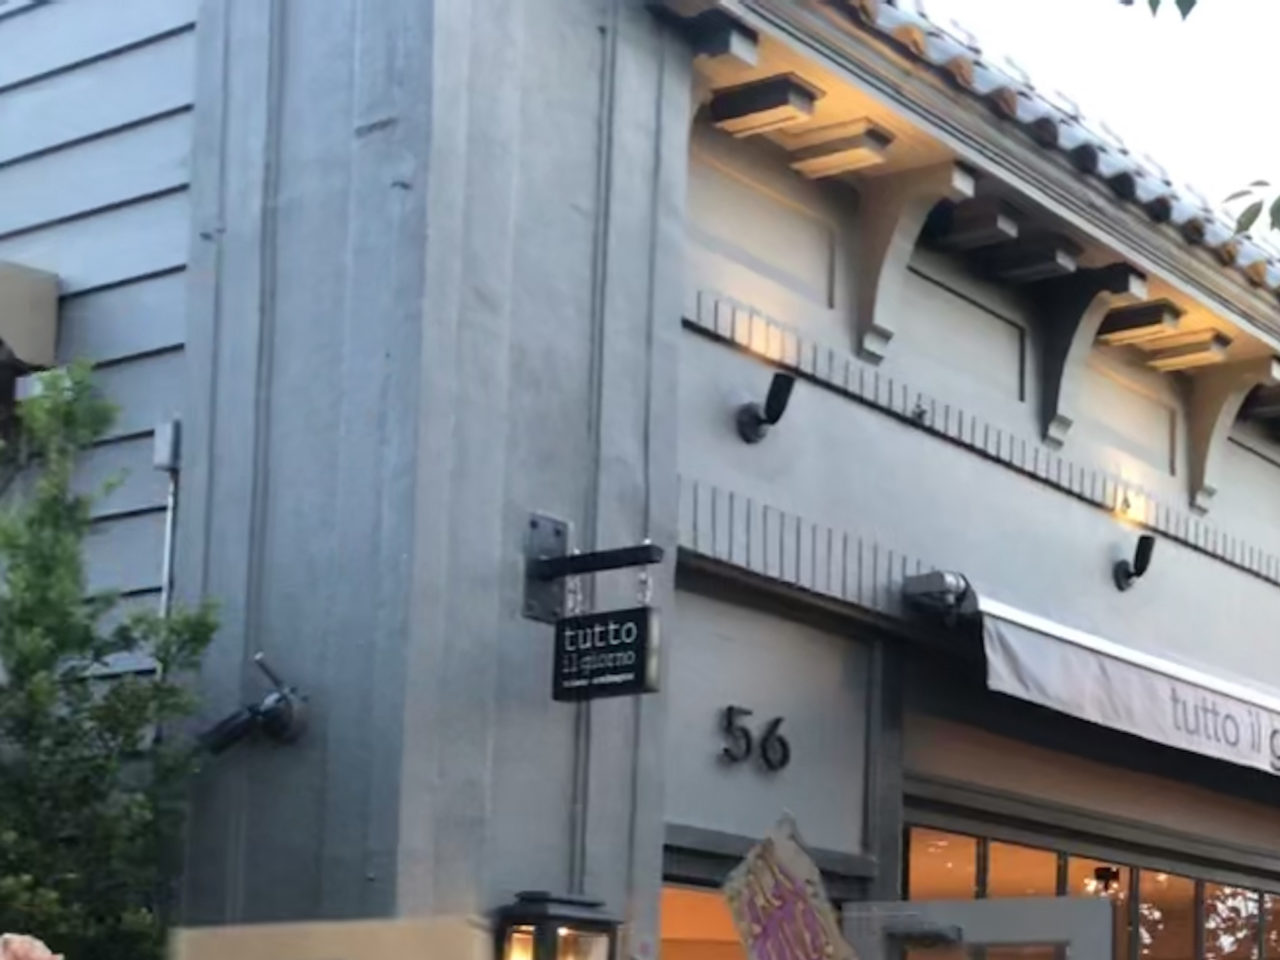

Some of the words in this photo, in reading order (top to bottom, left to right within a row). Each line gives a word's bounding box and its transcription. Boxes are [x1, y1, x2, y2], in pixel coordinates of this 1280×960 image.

[563, 621, 638, 651] tutto
[720, 704, 791, 772] 56
[1171, 686, 1241, 749] tutto
[1248, 709, 1262, 752] il
